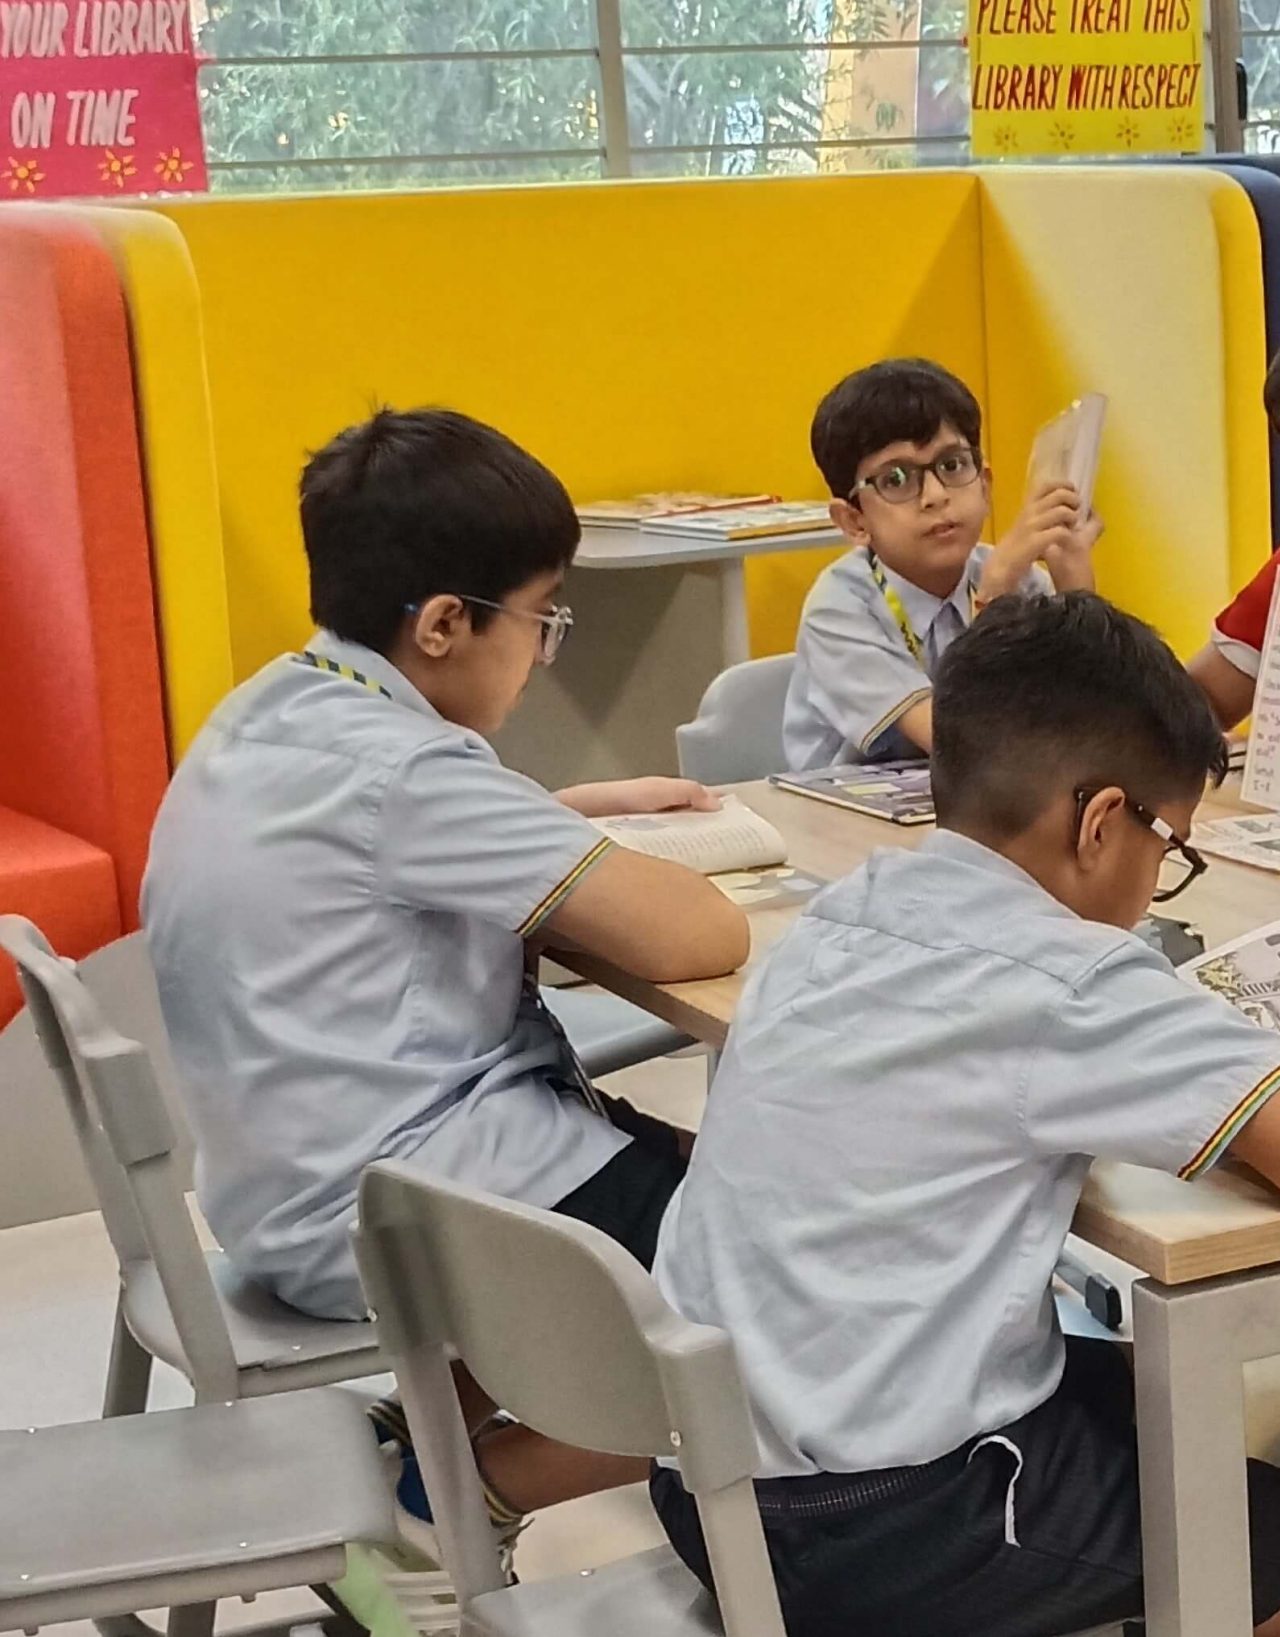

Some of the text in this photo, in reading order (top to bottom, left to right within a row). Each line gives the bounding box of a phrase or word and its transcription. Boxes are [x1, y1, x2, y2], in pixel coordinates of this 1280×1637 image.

[0, 0, 189, 58] YOUR LIBRARY
[976, 0, 1191, 35] PLEASE TREAT THIS
[972, 63, 1202, 111] LIBRARY WITH RESPECT
[11, 88, 139, 149] ON TIME
